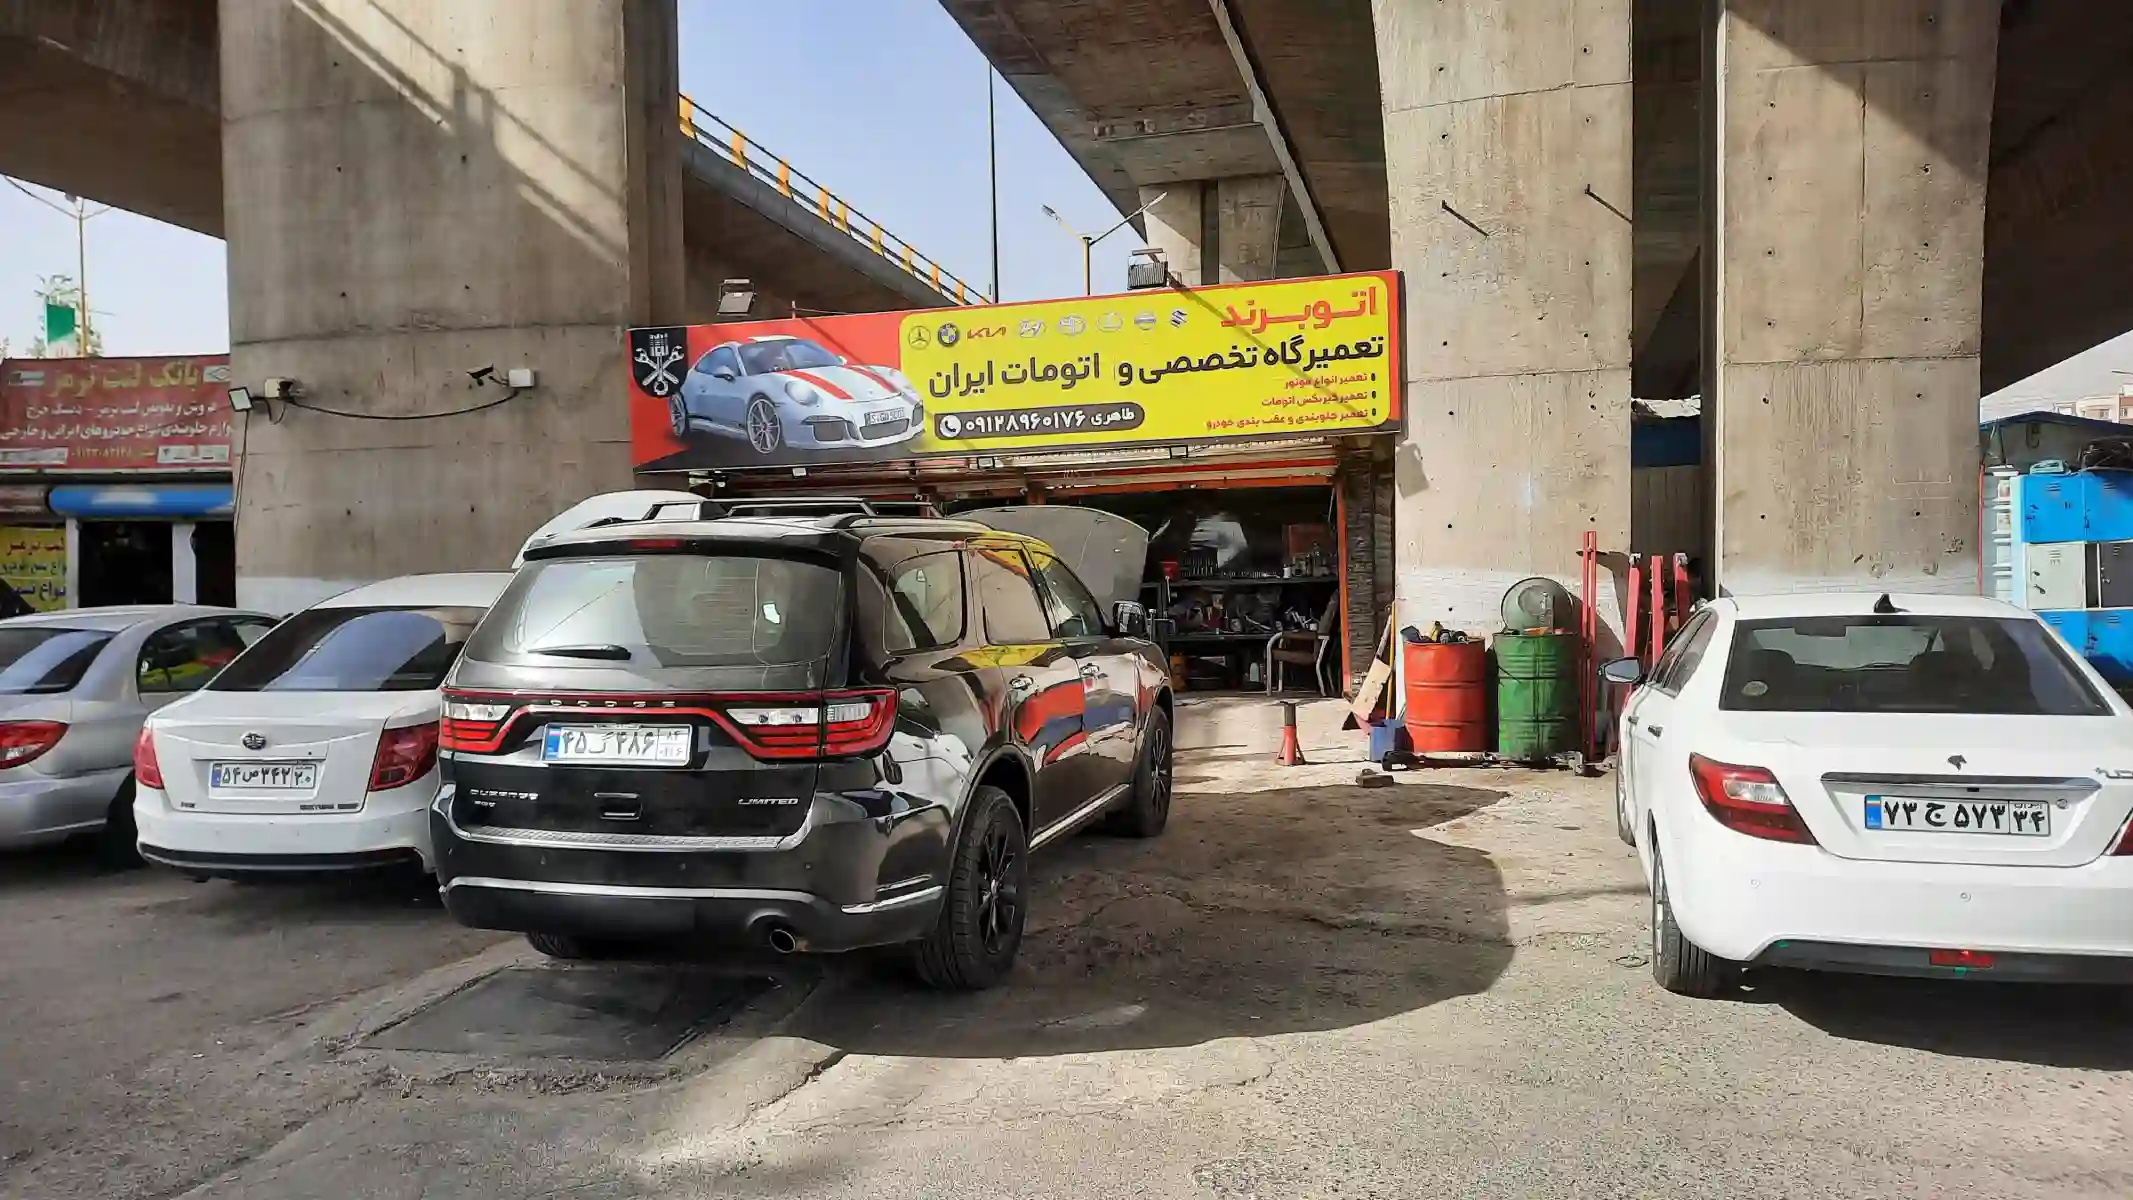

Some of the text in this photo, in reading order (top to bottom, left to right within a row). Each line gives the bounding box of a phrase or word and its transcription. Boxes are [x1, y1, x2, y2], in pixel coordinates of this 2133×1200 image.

[929, 335, 1385, 398] تعمیرگاه تخصصی و اتومات ایران
[1314, 375, 1338, 388] انواع
[1339, 372, 1368, 385] تعمیر
[1261, 396, 1295, 408] اتومات
[1339, 390, 1368, 403] تعمیر
[1091, 408, 1135, 426] طاهری
[1339, 408, 1369, 422] تعمیر
[737, 798, 799, 806] LIMITED
